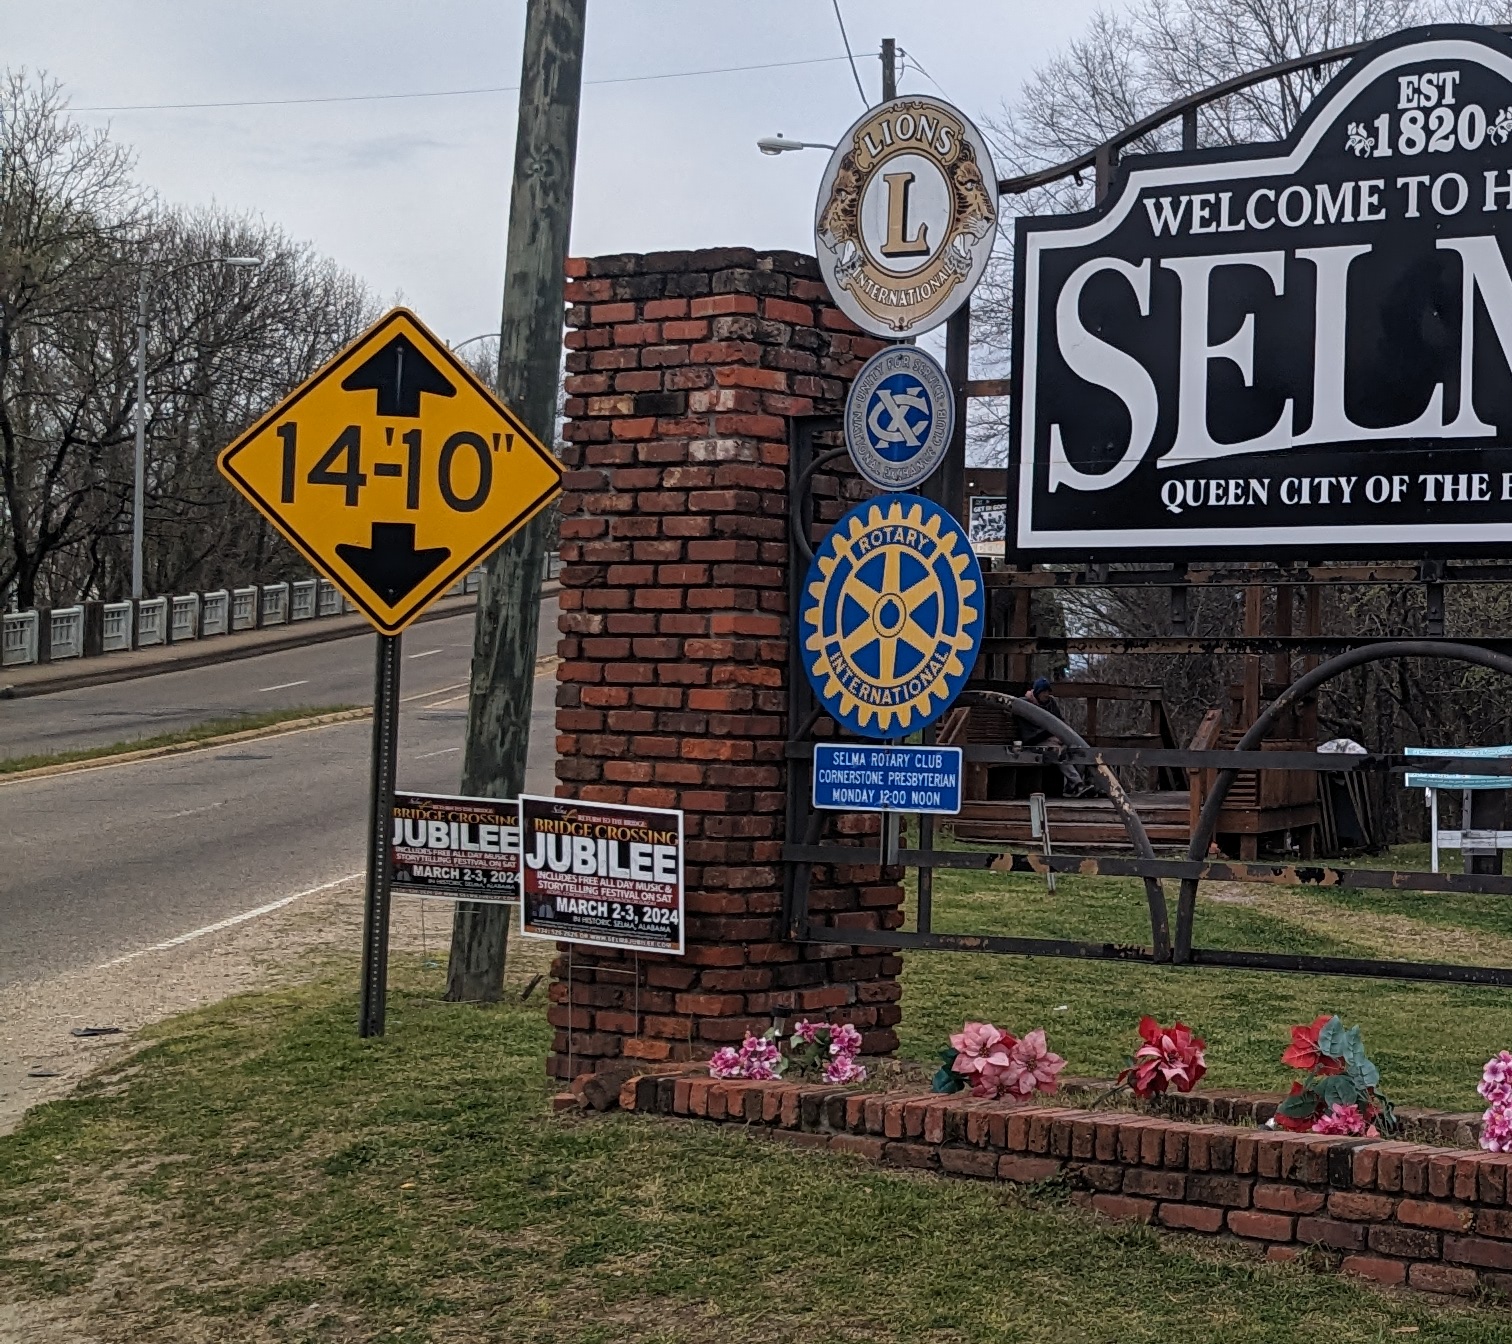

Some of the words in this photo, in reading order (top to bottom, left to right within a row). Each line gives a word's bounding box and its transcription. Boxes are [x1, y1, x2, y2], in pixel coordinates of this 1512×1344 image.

[1398, 71, 1461, 109] EST
[863, 113, 955, 158] LIONS
[1373, 104, 1487, 158] 1820
[881, 172, 931, 258] L
[1143, 180, 1389, 237] WELCOME
[1396, 171, 1470, 220] TO
[852, 264, 955, 307] INTERNATIONAL
[1161, 475, 1269, 515] QUEEN
[1279, 474, 1359, 506] CITY
[1363, 472, 1410, 504] OF
[1418, 471, 1493, 502] THE
[857, 529, 930, 555] ROTARY
[829, 651, 950, 705] INTERNATIONAL
[832, 751, 866, 766] SELMA
[871, 752, 911, 767] ROTARY
[914, 754, 943, 769] CLUB
[818, 769, 885, 786] CORNERSTONE
[888, 771, 956, 788] PRESBYTERIAN
[832, 788, 875, 803] MONDAY
[879, 789, 907, 805] 12:00
[911, 791, 941, 806] NOON
[394, 808, 445, 820] BRIDGE
[392, 817, 520, 853] JUBILEE
[535, 818, 592, 837] BRIDGE
[595, 825, 679, 846] CROSSING
[526, 833, 676, 883] JUBILEE
[413, 865, 459, 879] MARCH
[463, 869, 487, 883] 2-3,
[491, 871, 521, 884] 2024
[537, 871, 577, 883] INCLUDES
[579, 876, 599, 885] FREE
[600, 878, 615, 887] ALL
[617, 880, 634, 889] DAY
[635, 882, 664, 892] MUSIC
[665, 885, 672, 893] &
[538, 880, 598, 895] STORYTELLING
[601, 888, 640, 899] FESTIVAL
[641, 892, 655, 901] ON
[656, 894, 673, 903] SAT
[557, 897, 607, 917] MARCH
[612, 903, 638, 924] 2-3,
[643, 907, 678, 925] 2024
